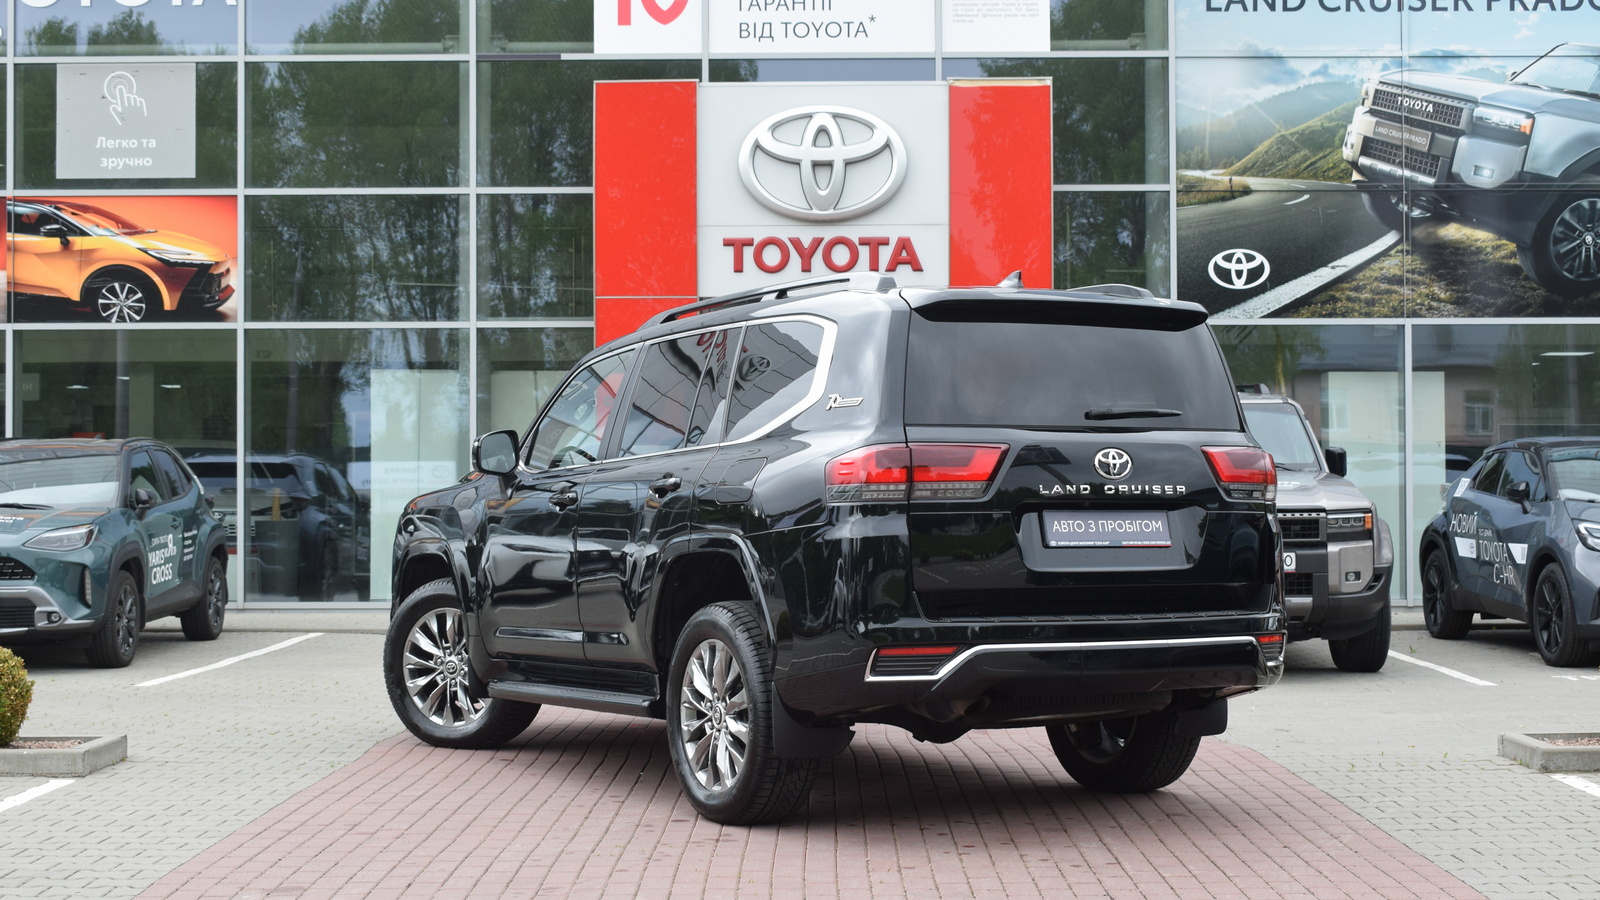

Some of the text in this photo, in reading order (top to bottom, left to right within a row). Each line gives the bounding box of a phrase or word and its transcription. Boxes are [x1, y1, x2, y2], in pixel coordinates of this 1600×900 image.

[739, 22, 774, 42] ВІД
[1397, 96, 1433, 113] TOYOTA
[1375, 125, 1388, 135] LAND
[95, 136, 156, 149] Легко та
[100, 157, 153, 170] зручно
[722, 235, 924, 274] TOYOTA
[1038, 484, 1186, 495] LAND CRUISER
[1052, 520, 1163, 532] АВТО З ПРОБІГОМ
[1449, 511, 1478, 535] НОВИЙ
[148, 549, 165, 567] YARIS
[1478, 540, 1510, 562] TOYOTA
[151, 563, 173, 585] CROSS
[1493, 563, 1516, 586] C-HR
